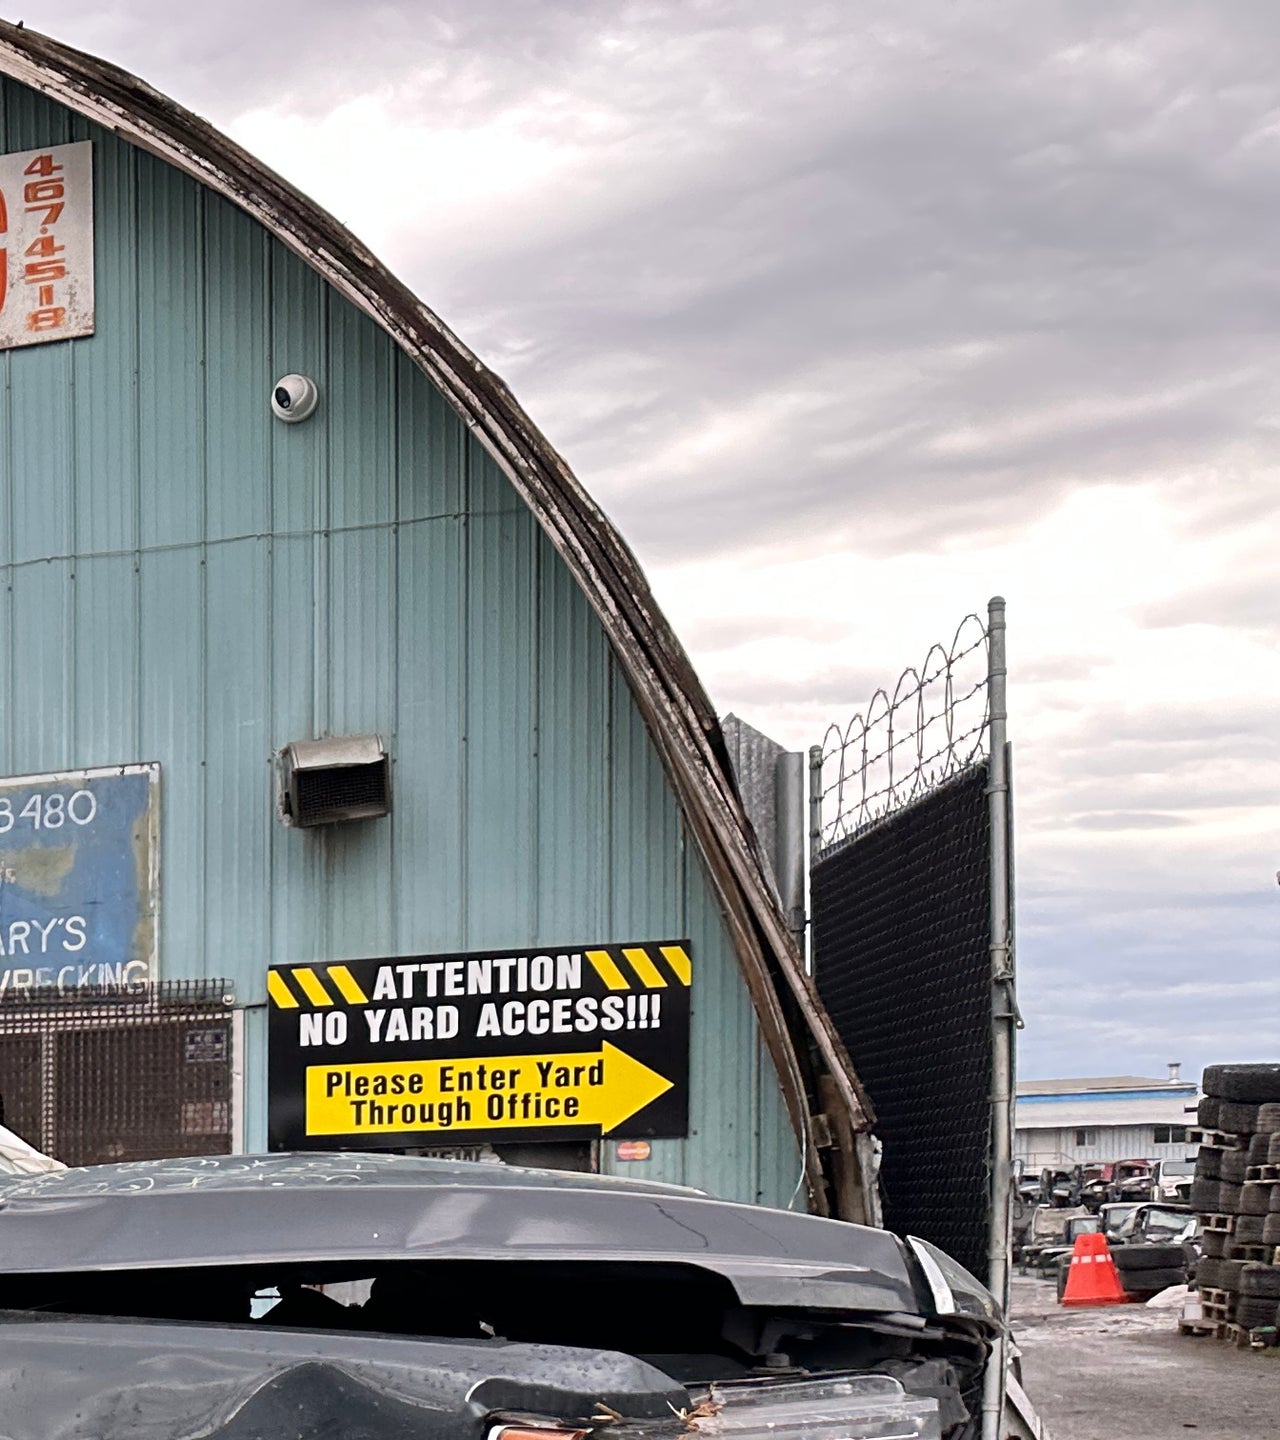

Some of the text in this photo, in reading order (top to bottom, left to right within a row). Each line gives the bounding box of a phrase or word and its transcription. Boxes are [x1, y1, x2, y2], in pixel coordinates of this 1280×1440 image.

[372, 953, 583, 1001] ATTENTION
[299, 993, 662, 1047] NO YARD ACCESS!!!
[325, 1058, 605, 1099] Please Enter Yard
[349, 1091, 580, 1128] Through Office
